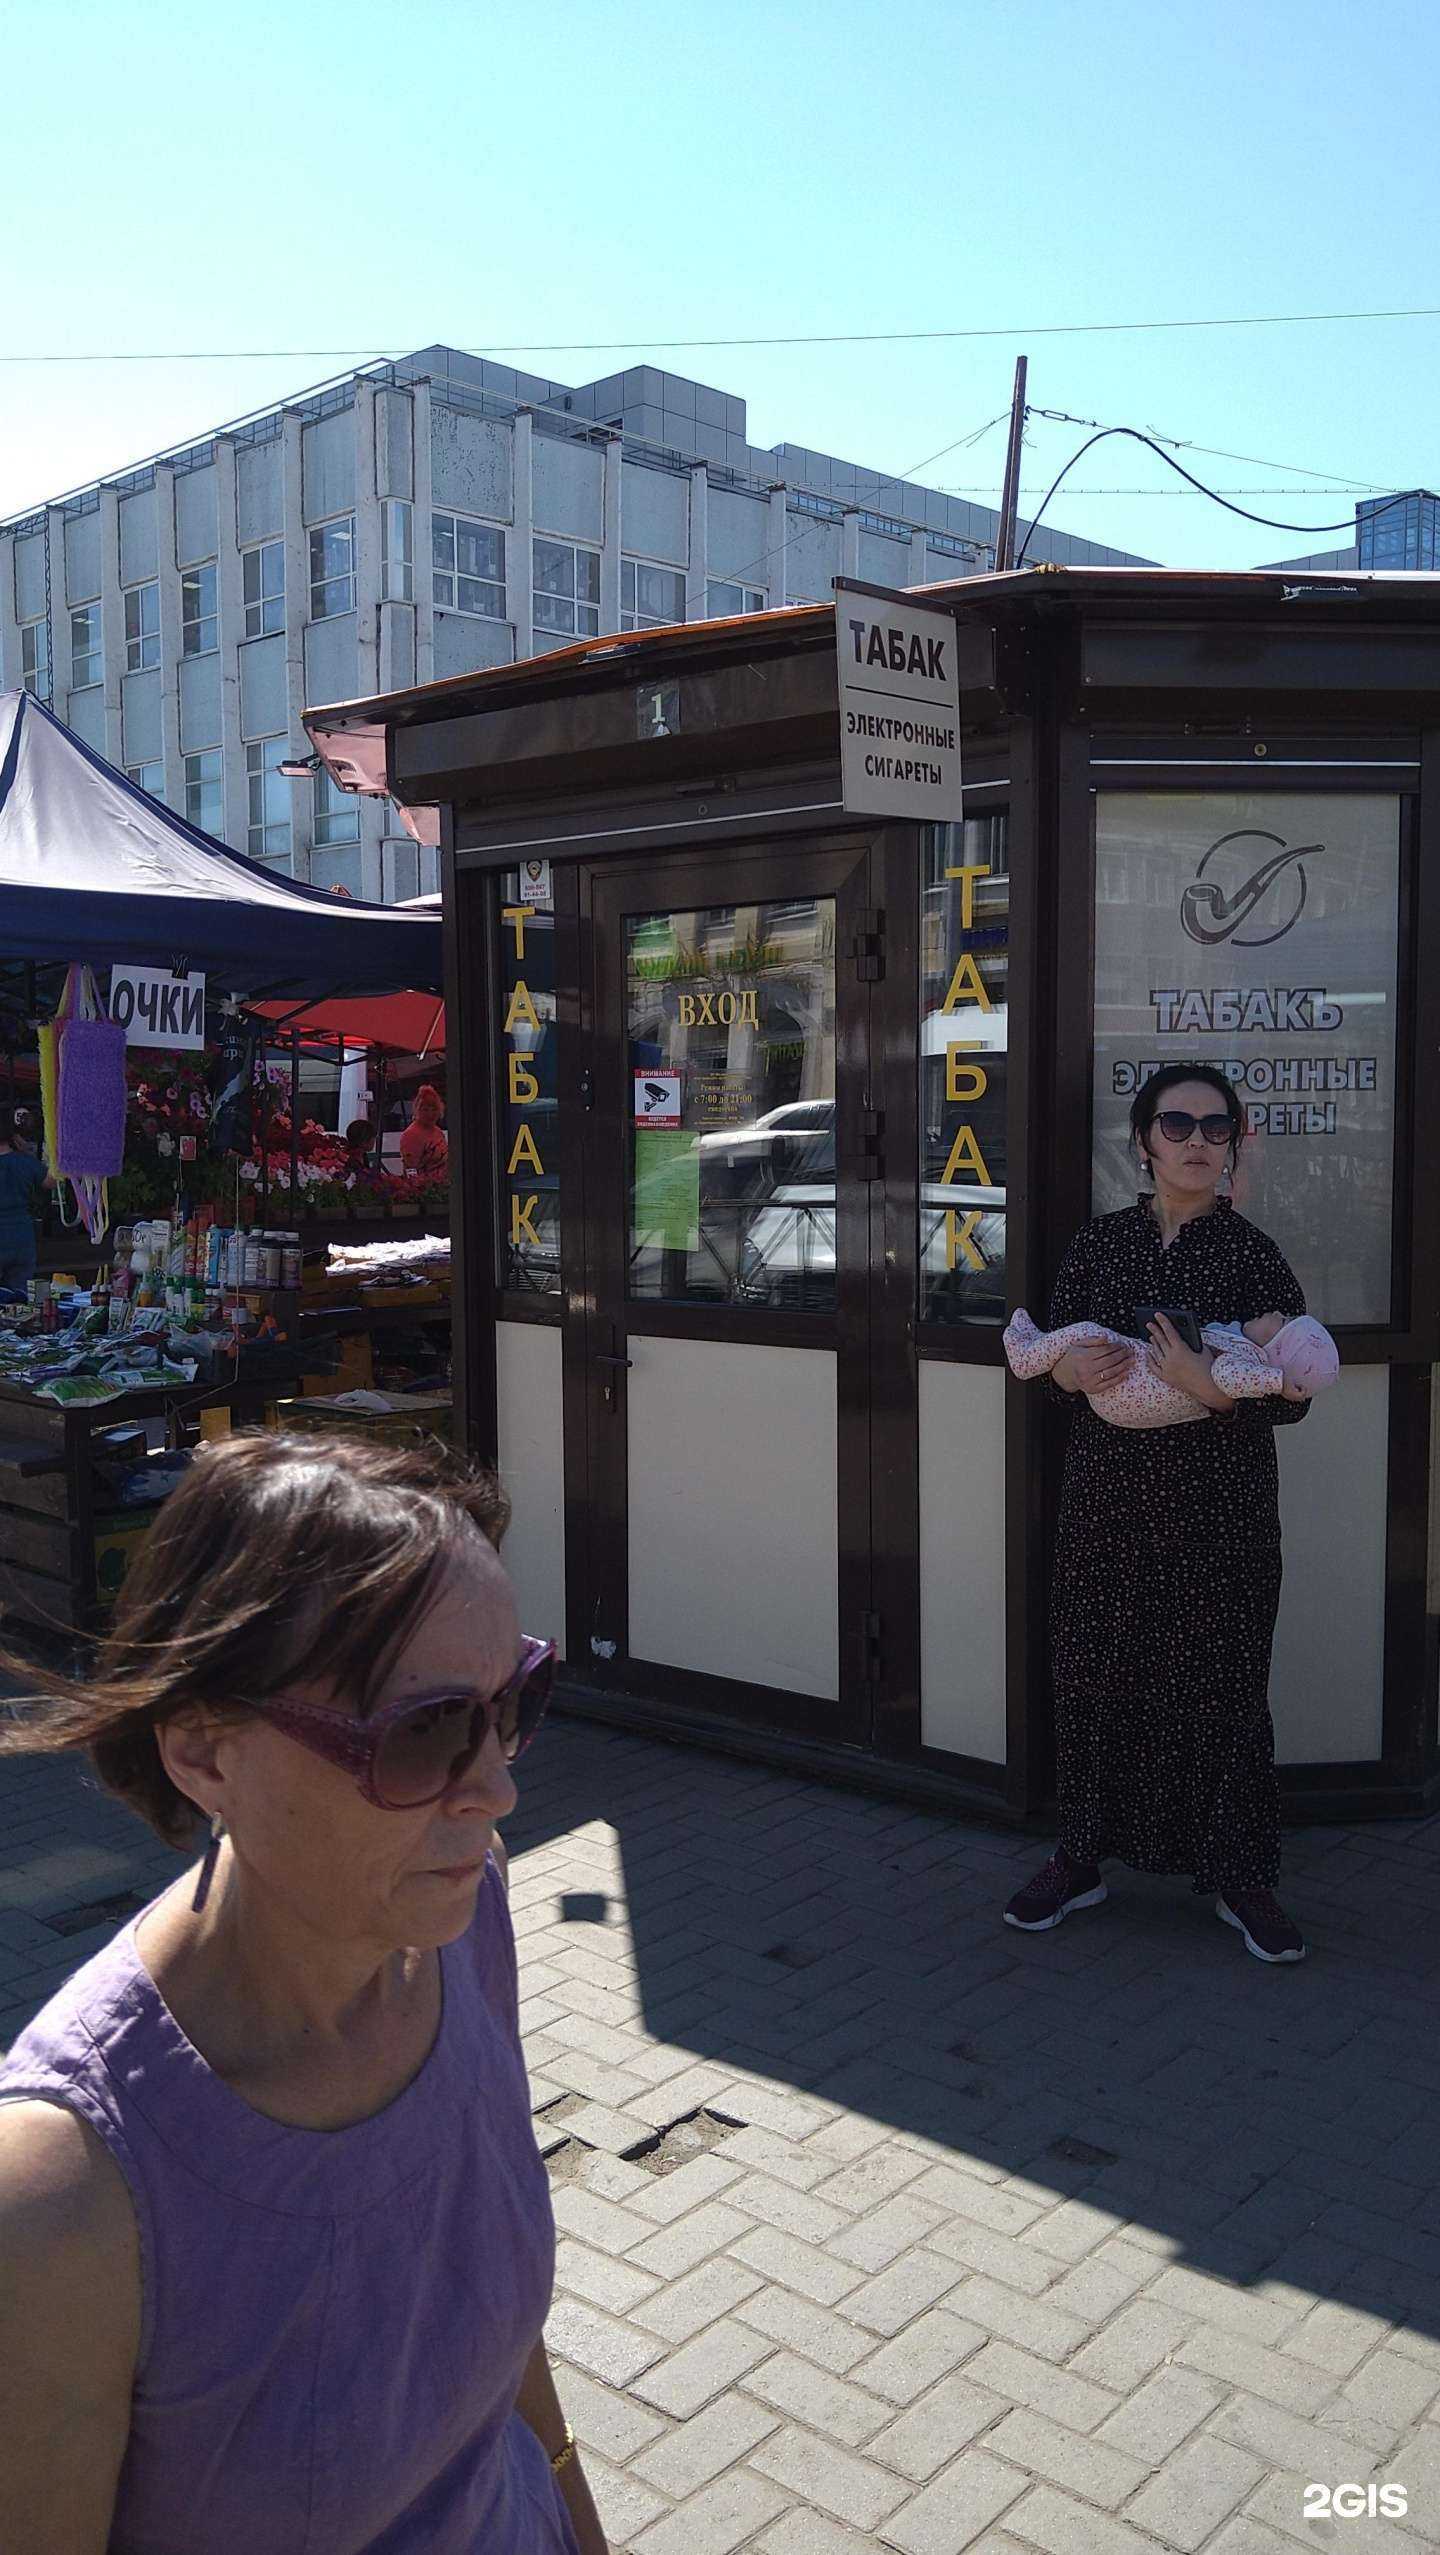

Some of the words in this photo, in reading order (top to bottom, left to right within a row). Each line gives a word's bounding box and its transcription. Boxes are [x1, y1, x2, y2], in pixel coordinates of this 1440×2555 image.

[848, 619, 947, 682] ТАБАК
[651, 693, 666, 724] 1
[847, 711, 955, 750] ЭЛЕКТРОННЫЕ
[864, 754, 942, 785] СИГАРЕТЫ
[112, 979, 204, 1036] ОЧКИ
[678, 990, 759, 1031] ВХОД
[1150, 988, 1344, 1033] ТАБАКЪ
[502, 906, 545, 1246] ТАБАК
[940, 864, 993, 1271] ТАБАК
[1113, 1057, 1378, 1095] ЭЛРОННЫЕ
